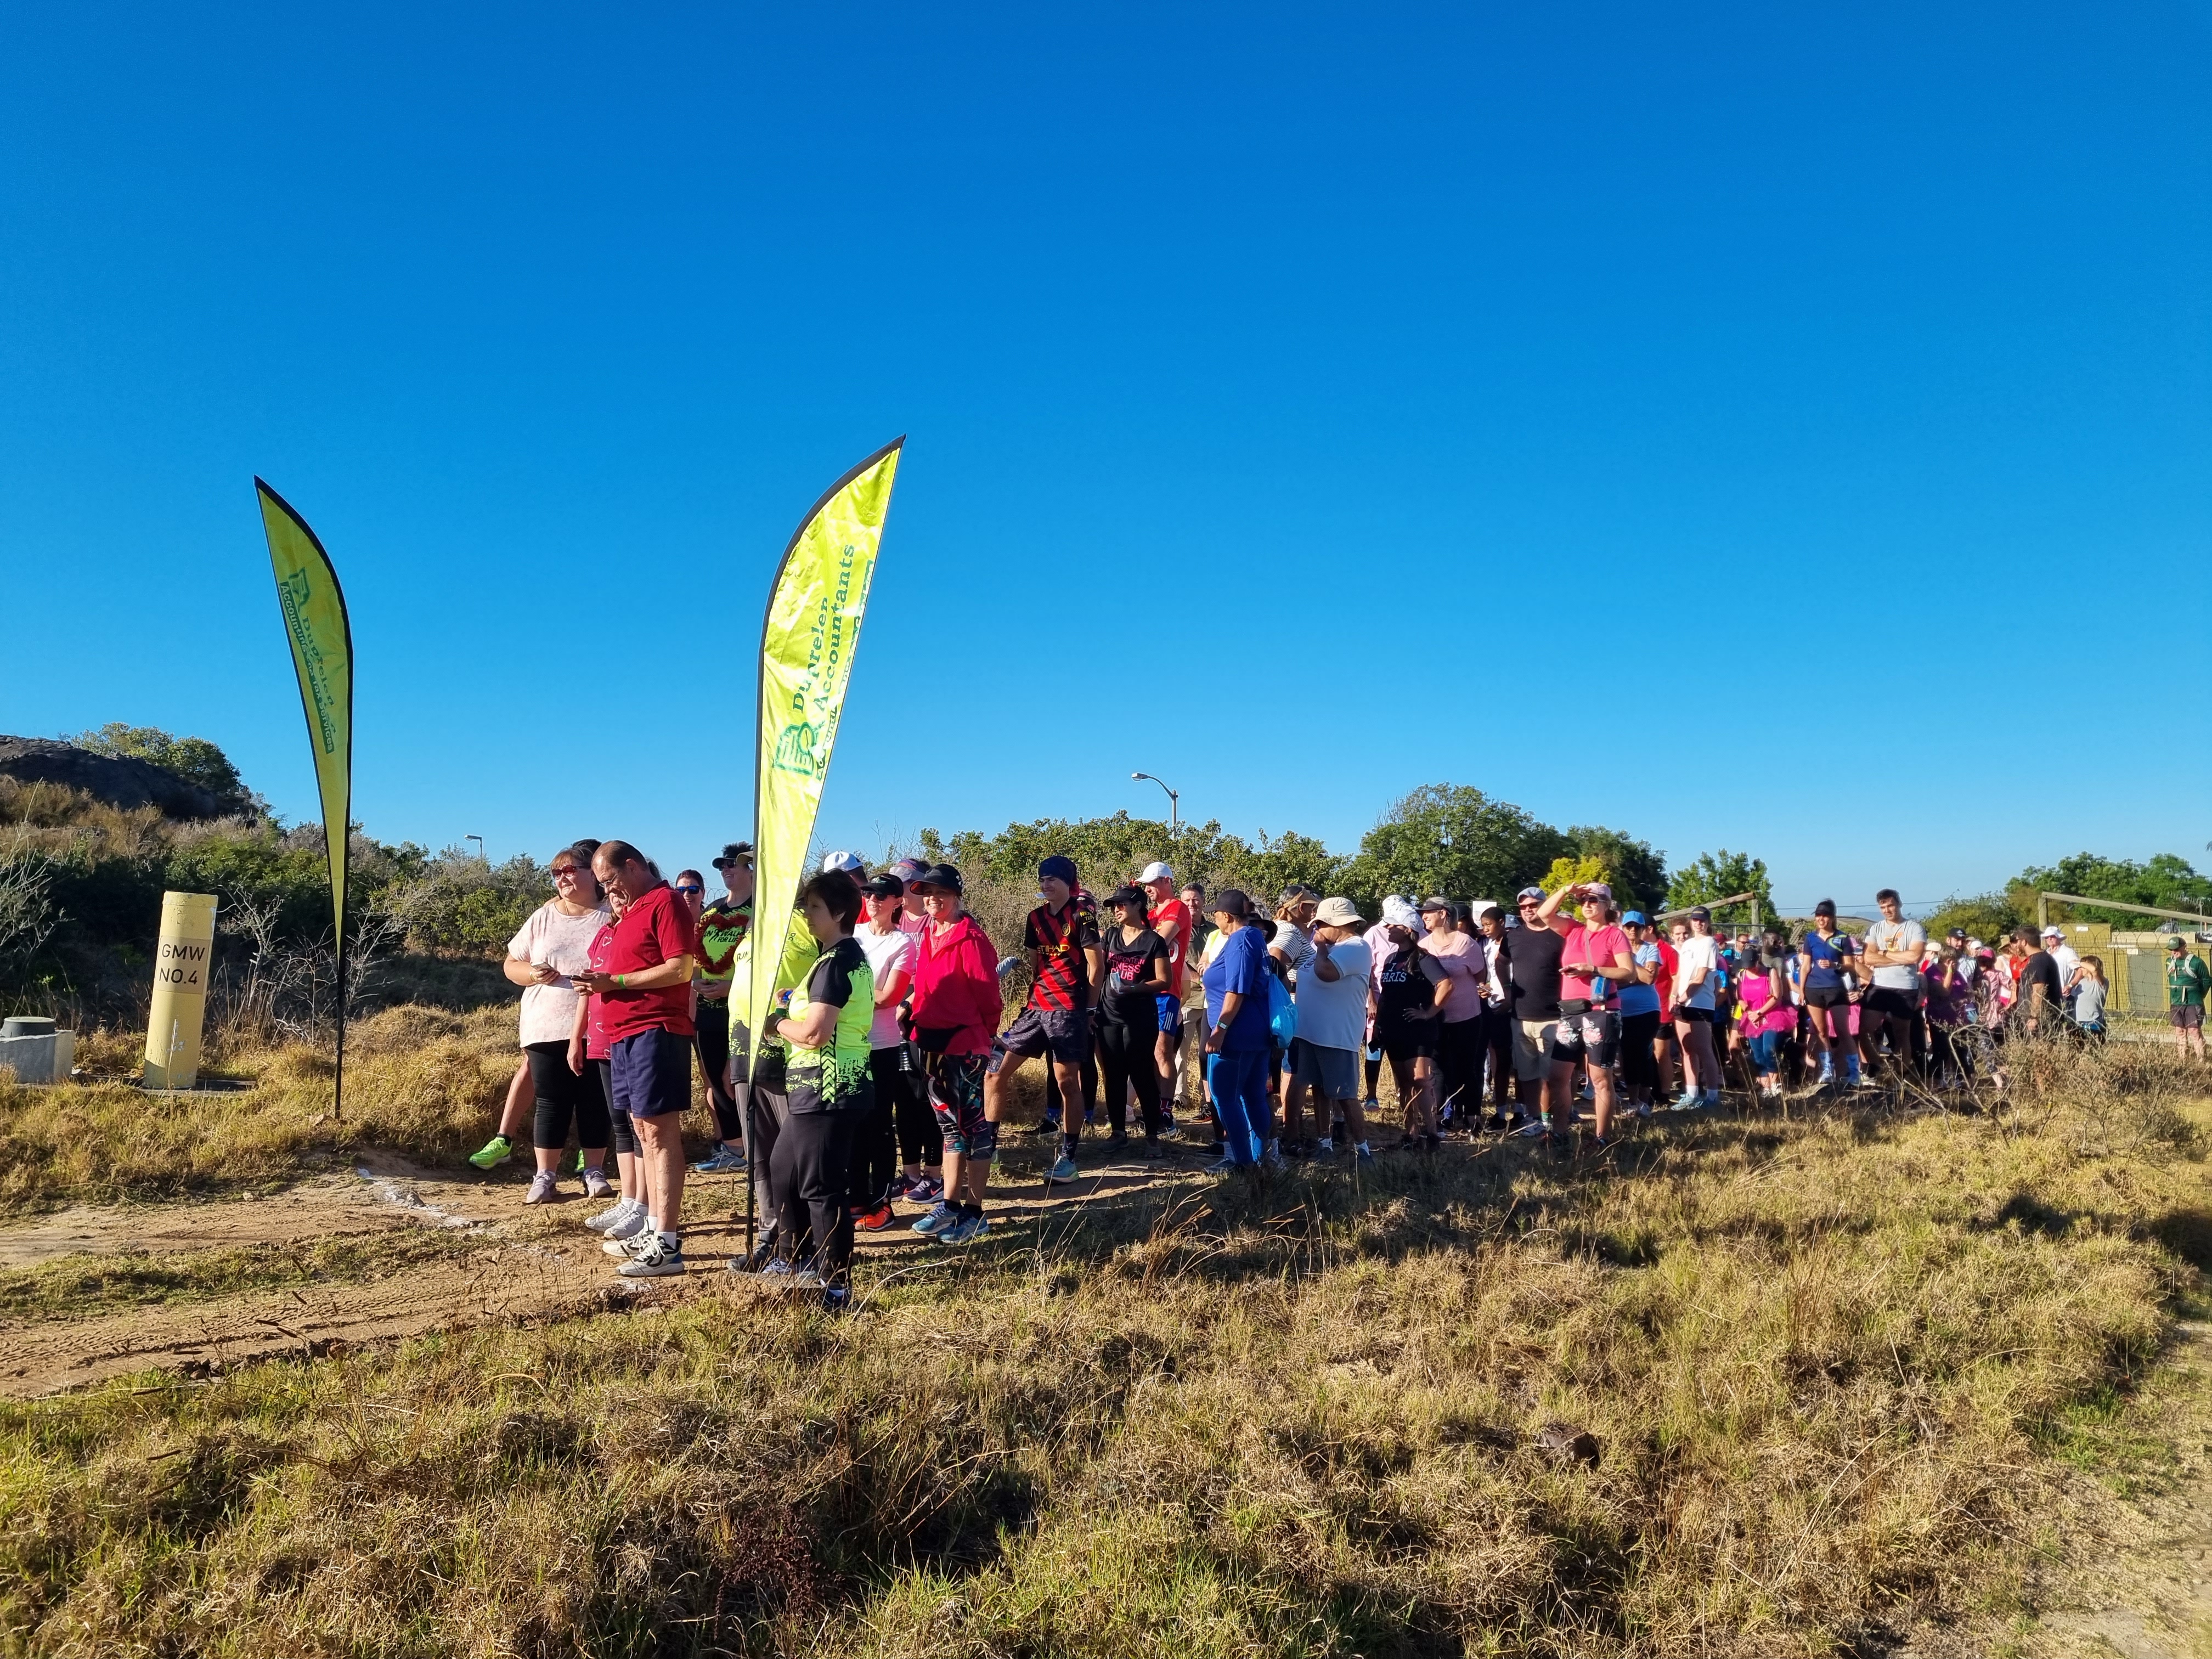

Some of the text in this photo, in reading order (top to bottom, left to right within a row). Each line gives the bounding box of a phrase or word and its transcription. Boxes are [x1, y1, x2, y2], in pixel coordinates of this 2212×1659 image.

[814, 545, 855, 712] Accountants
[793, 597, 827, 713] Duprelen
[162, 944, 205, 962] GMW
[1389, 962, 1397, 972] I
[159, 968, 198, 985] NO.4
[1381, 971, 1407, 982] PARIS
